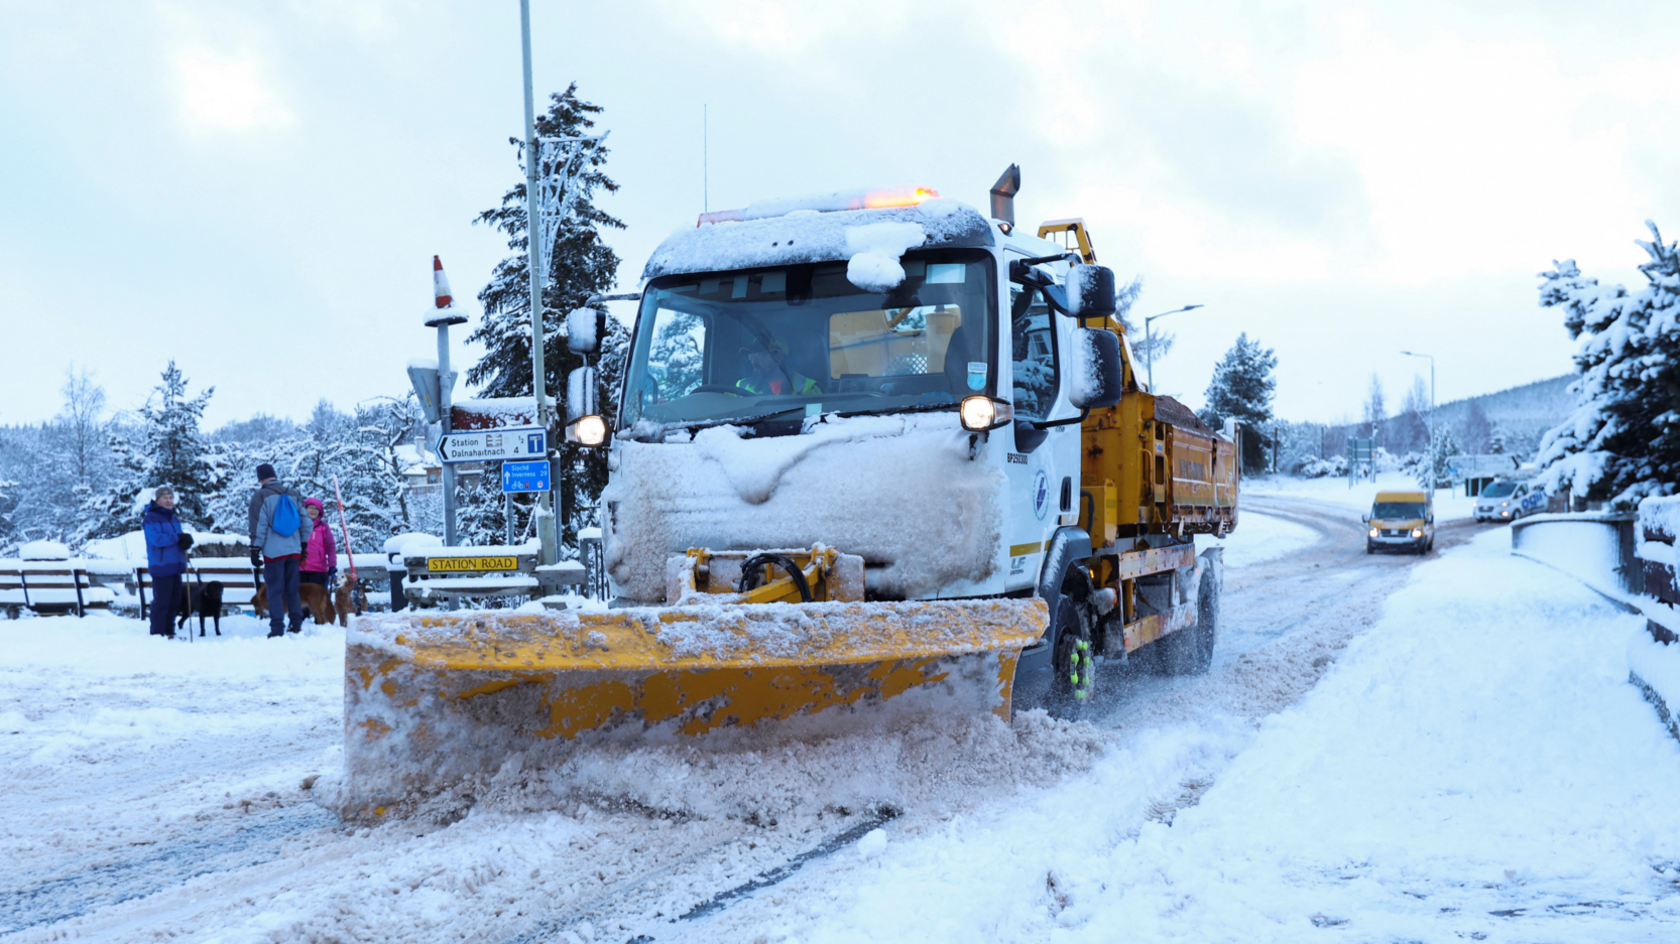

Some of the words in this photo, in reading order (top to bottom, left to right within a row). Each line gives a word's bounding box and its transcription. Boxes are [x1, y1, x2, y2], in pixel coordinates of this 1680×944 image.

[451, 438, 479, 447] Station
[451, 447, 506, 458] Dalnahaitnach
[513, 446, 520, 454] 4
[511, 464, 530, 472] Slochd
[511, 470, 536, 478] Inverness
[432, 558, 477, 569] STATION
[481, 557, 513, 569] ROAD
